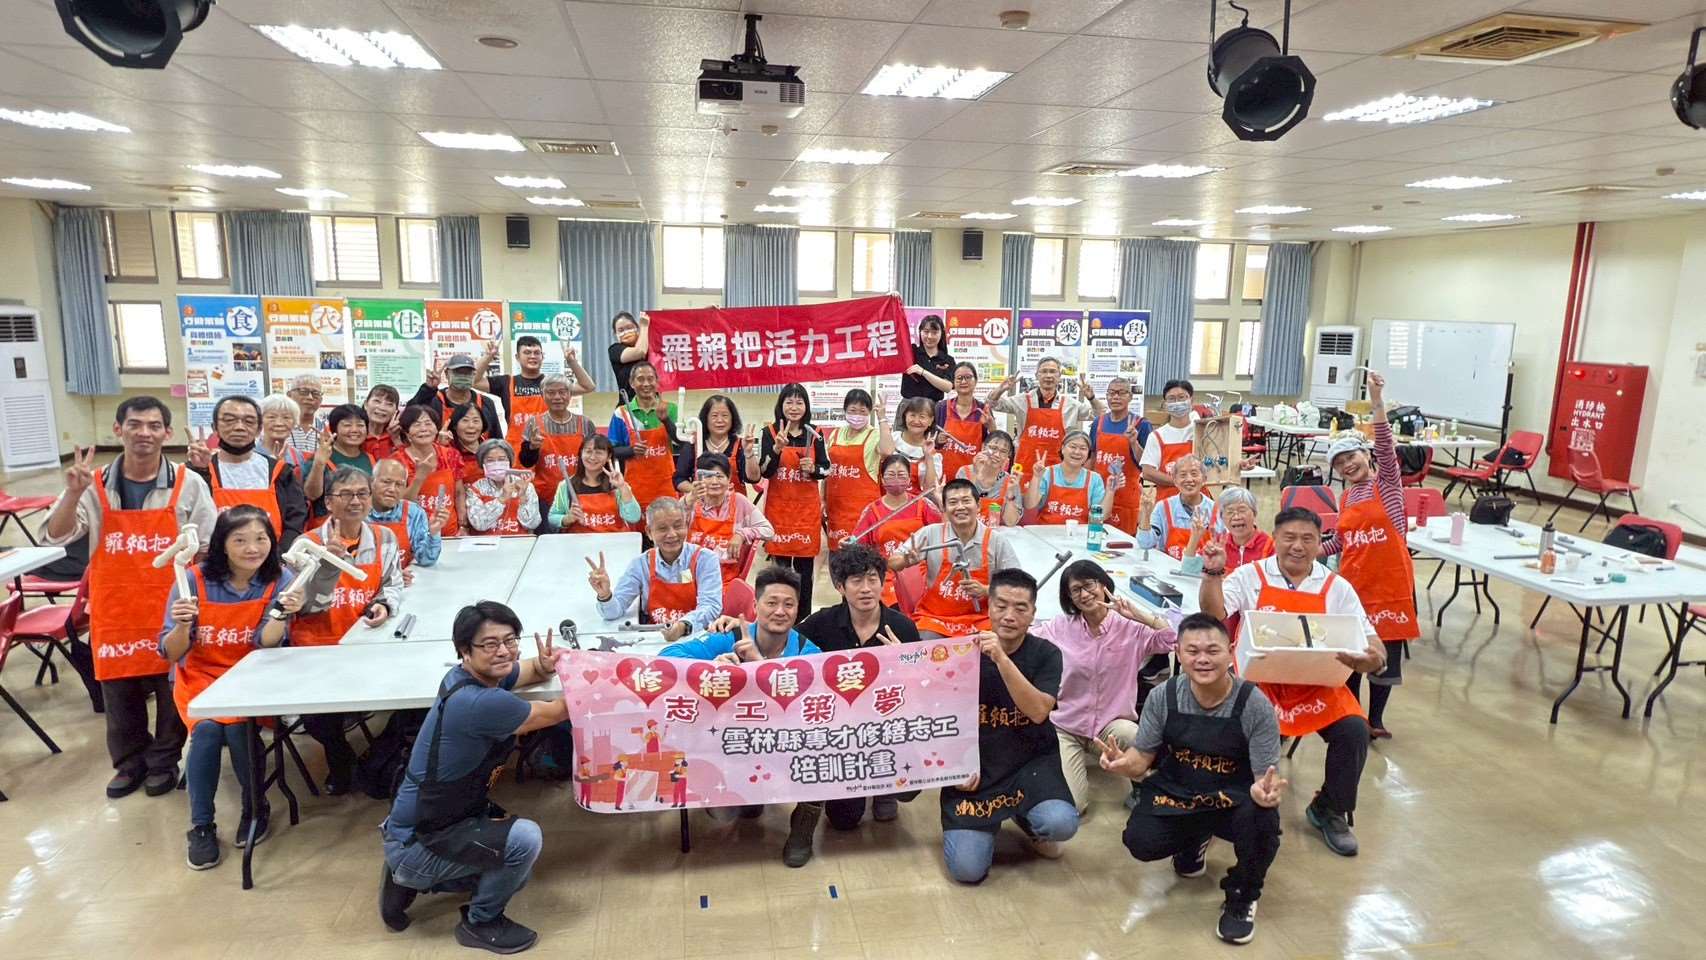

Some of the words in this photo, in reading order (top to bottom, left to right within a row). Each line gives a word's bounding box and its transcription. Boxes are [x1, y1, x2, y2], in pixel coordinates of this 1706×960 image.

[232, 309, 252, 331] 食
[315, 308, 336, 330] 衣
[397, 311, 420, 334] 住
[473, 312, 496, 336] 行
[556, 316, 576, 336] 醫
[985, 323, 1007, 340] 心
[1060, 321, 1080, 341] 樂
[1127, 322, 1146, 342] 學
[661, 320, 899, 372] 羅賴把活力工程
[1571, 417, 1604, 431] 出水口
[1573, 409, 1605, 421] HYDRANT
[631, 660, 870, 698] 修繕傳愛
[664, 685, 905, 725] 志工築夢
[722, 714, 960, 755] 雲林縣專才修繕志工
[790, 750, 898, 784] 培訓計畫
